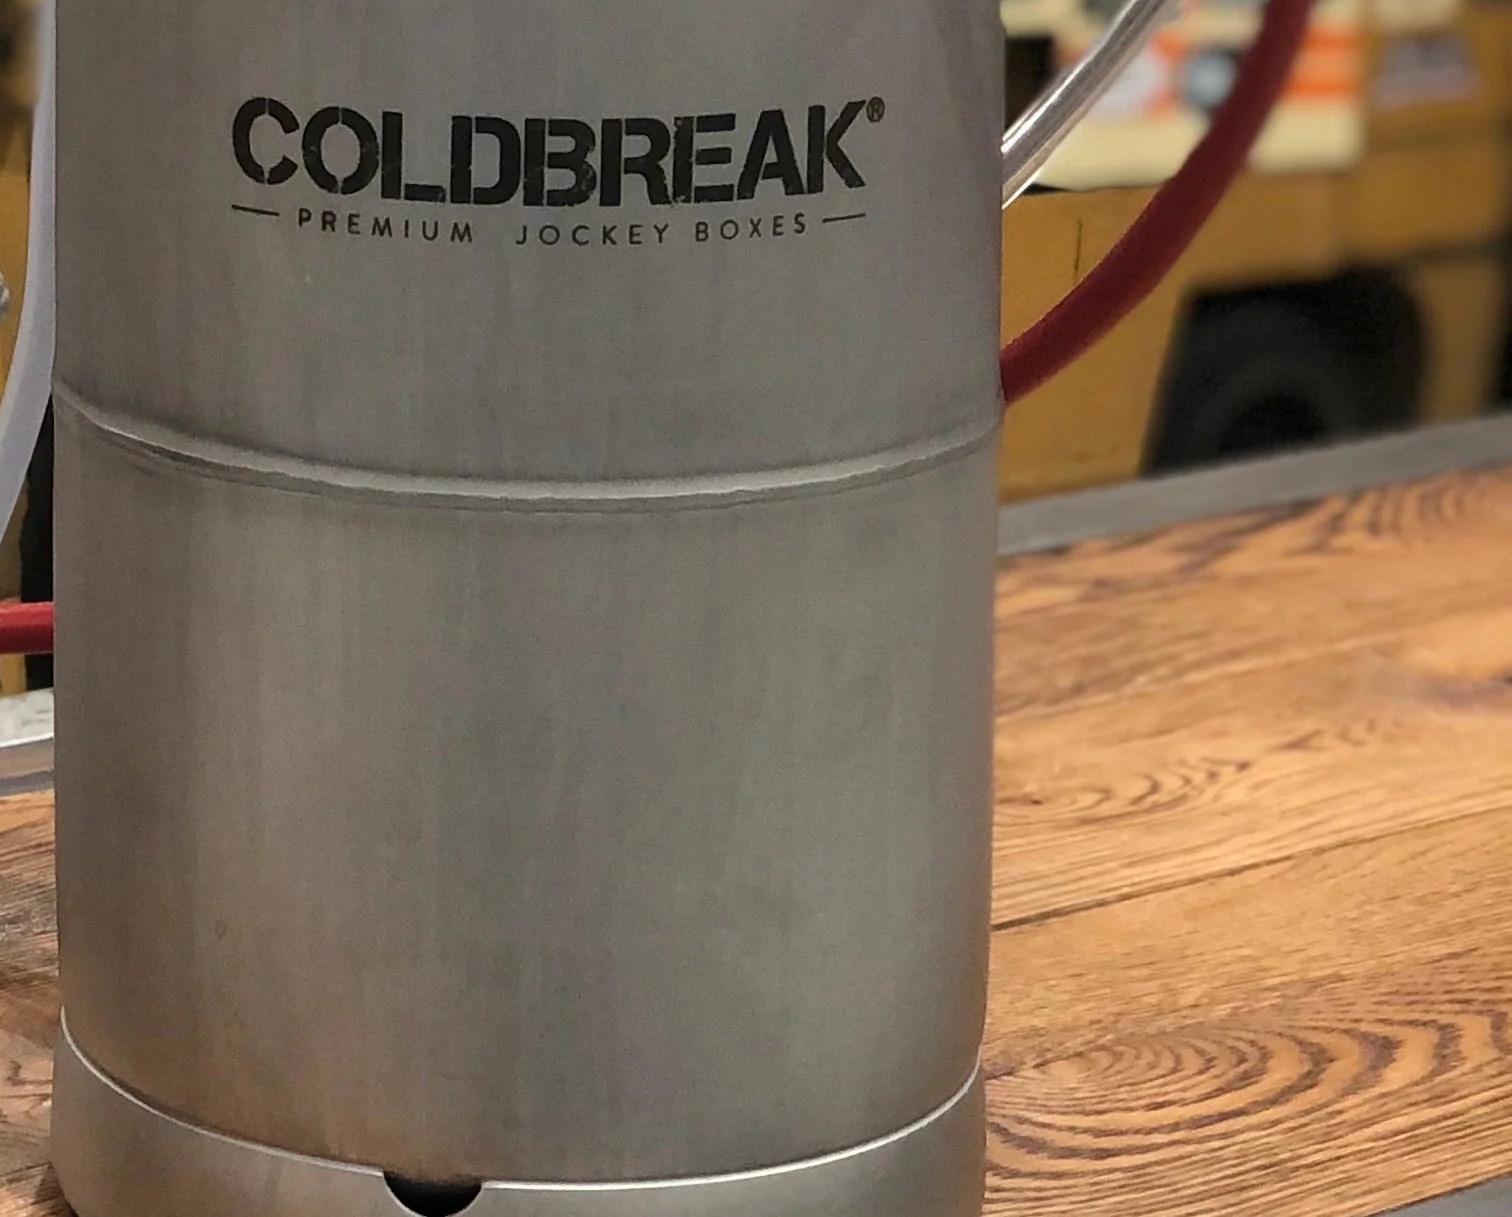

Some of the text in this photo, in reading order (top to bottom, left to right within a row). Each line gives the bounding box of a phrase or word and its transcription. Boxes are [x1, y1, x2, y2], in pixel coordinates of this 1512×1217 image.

[298, 209, 806, 245] PREMIUM JOCKEY BOXES
